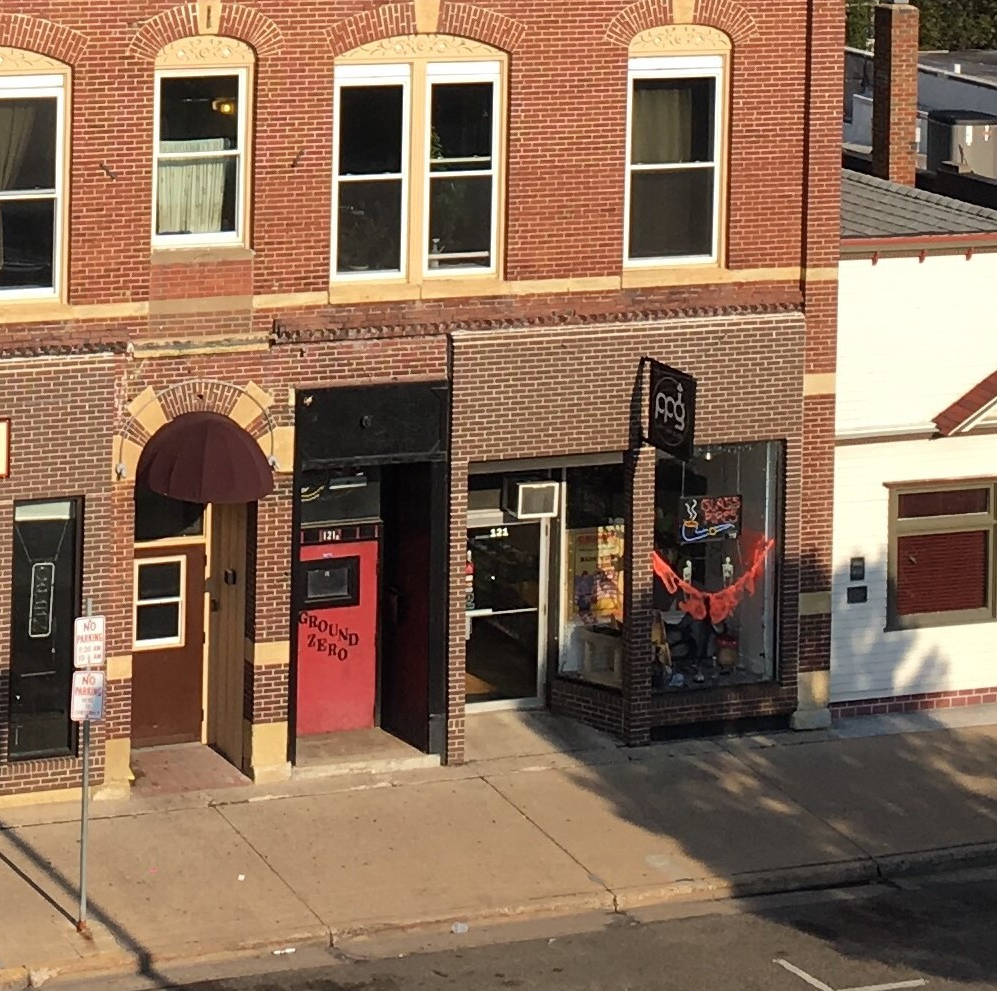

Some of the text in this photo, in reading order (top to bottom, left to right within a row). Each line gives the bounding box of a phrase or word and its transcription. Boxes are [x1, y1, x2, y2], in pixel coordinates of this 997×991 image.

[490, 528, 509, 537] 121
[83, 622, 97, 632] NO
[298, 611, 359, 646] GROUND
[76, 633, 103, 644] PARKING
[307, 634, 348, 661] ZERO
[82, 676, 96, 686] NO
[75, 687, 102, 696] PARKING
